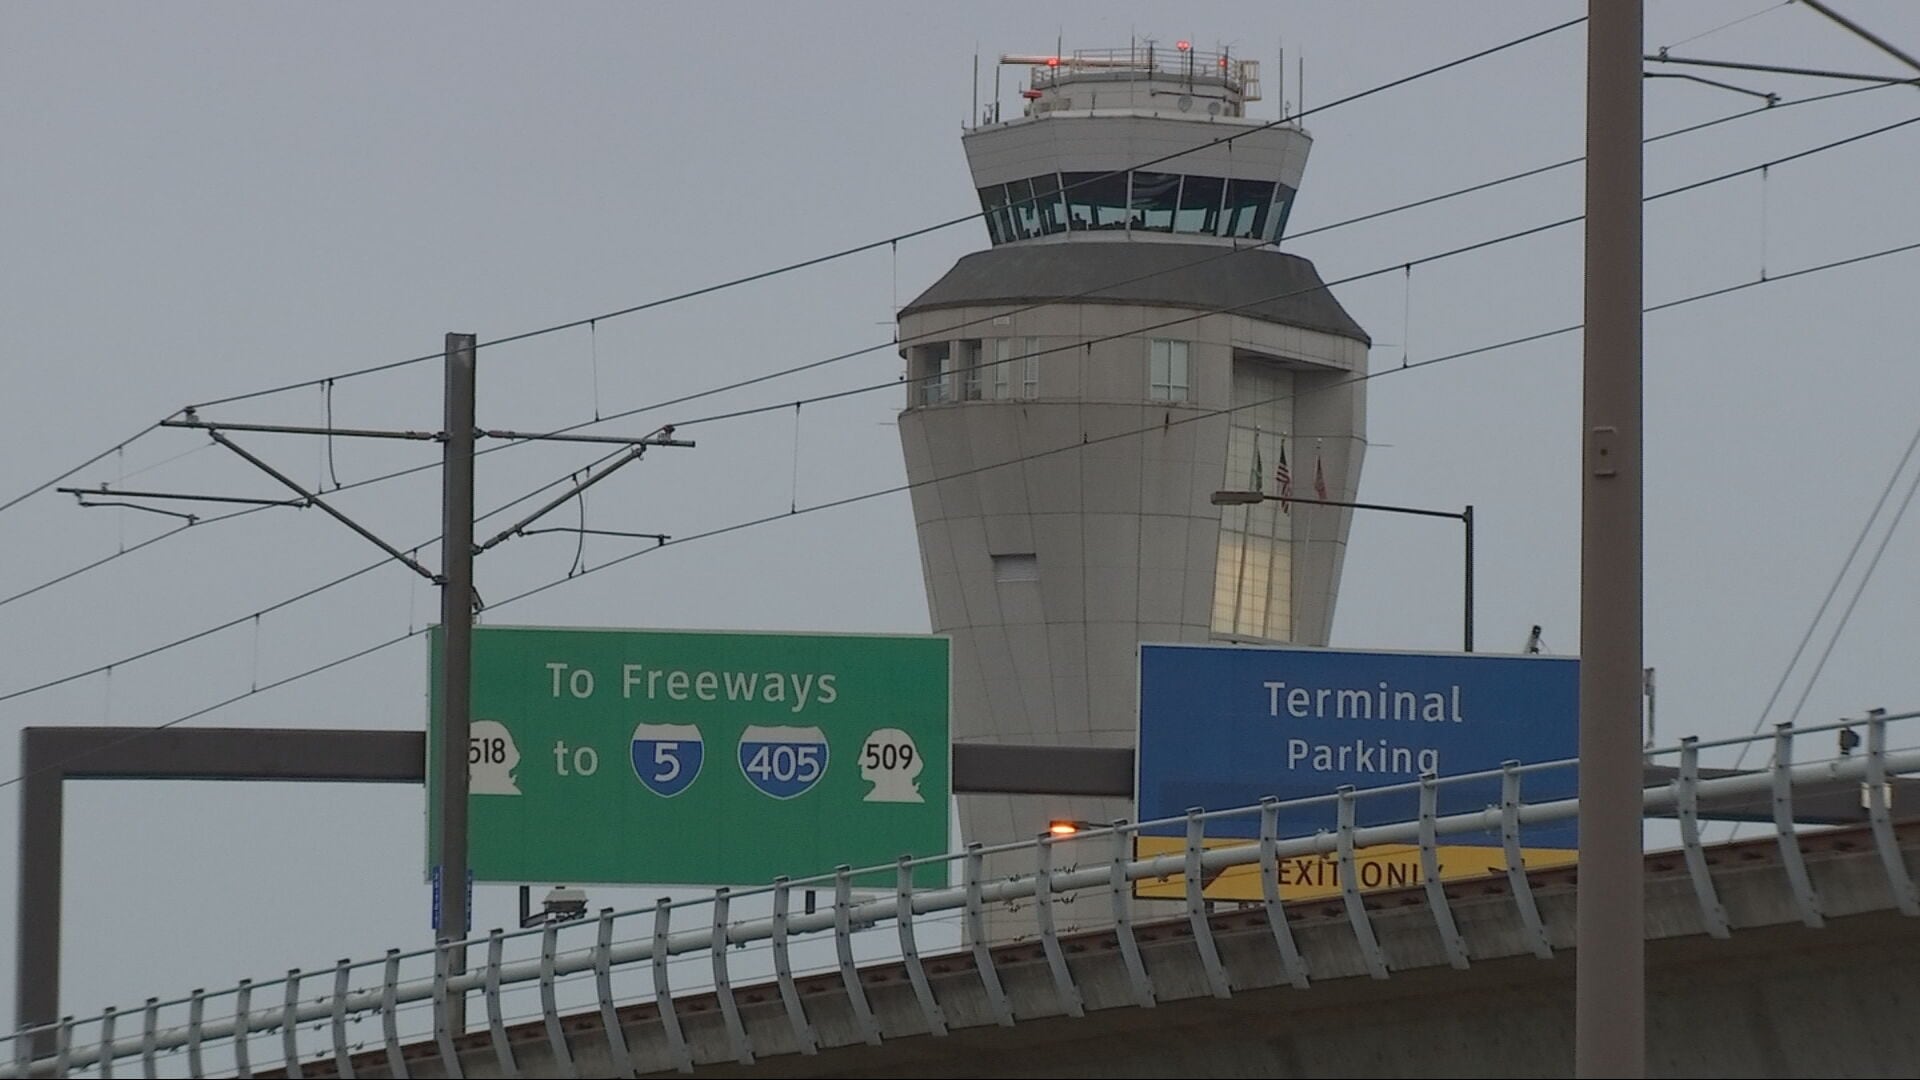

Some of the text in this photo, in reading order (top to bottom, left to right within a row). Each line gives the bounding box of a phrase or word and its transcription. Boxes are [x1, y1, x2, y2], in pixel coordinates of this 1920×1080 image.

[545, 662, 838, 712] To Freeways
[1263, 681, 1464, 723] Terminal
[469, 737, 913, 782] 518 to 5 405 509
[1287, 738, 1439, 774] Parking
[1278, 858, 1444, 888] EXIT ONL
